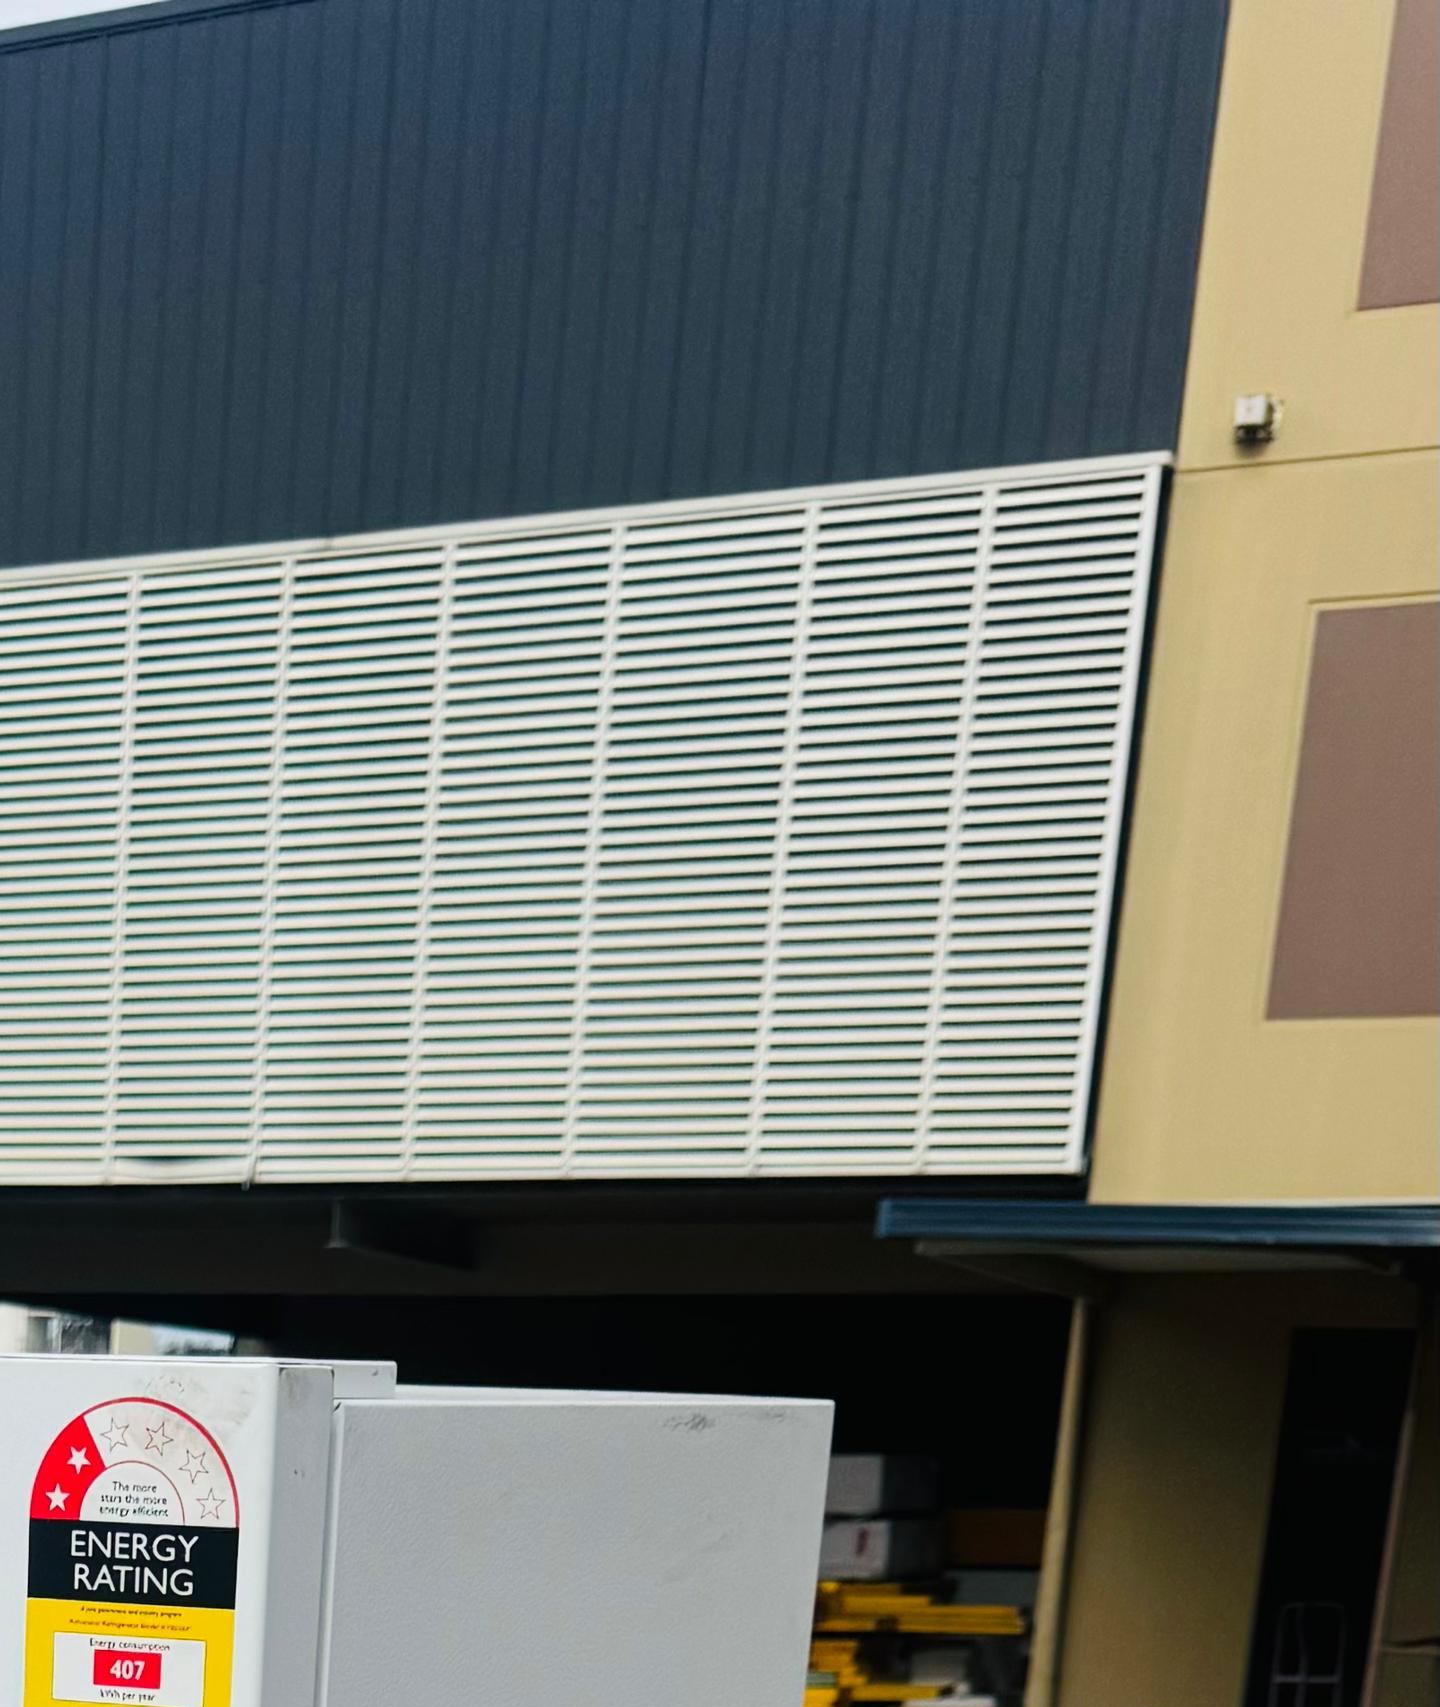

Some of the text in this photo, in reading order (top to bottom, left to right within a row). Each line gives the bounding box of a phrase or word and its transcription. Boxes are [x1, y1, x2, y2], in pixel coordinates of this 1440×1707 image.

[112, 1481, 157, 1493] The more
[125, 1494, 140, 1504] the
[70, 1529, 199, 1563] ENERGY
[73, 1563, 194, 1596] RATING
[89, 1637, 116, 1649] Energy
[109, 1659, 146, 1681] 407
[122, 1691, 136, 1701] per
